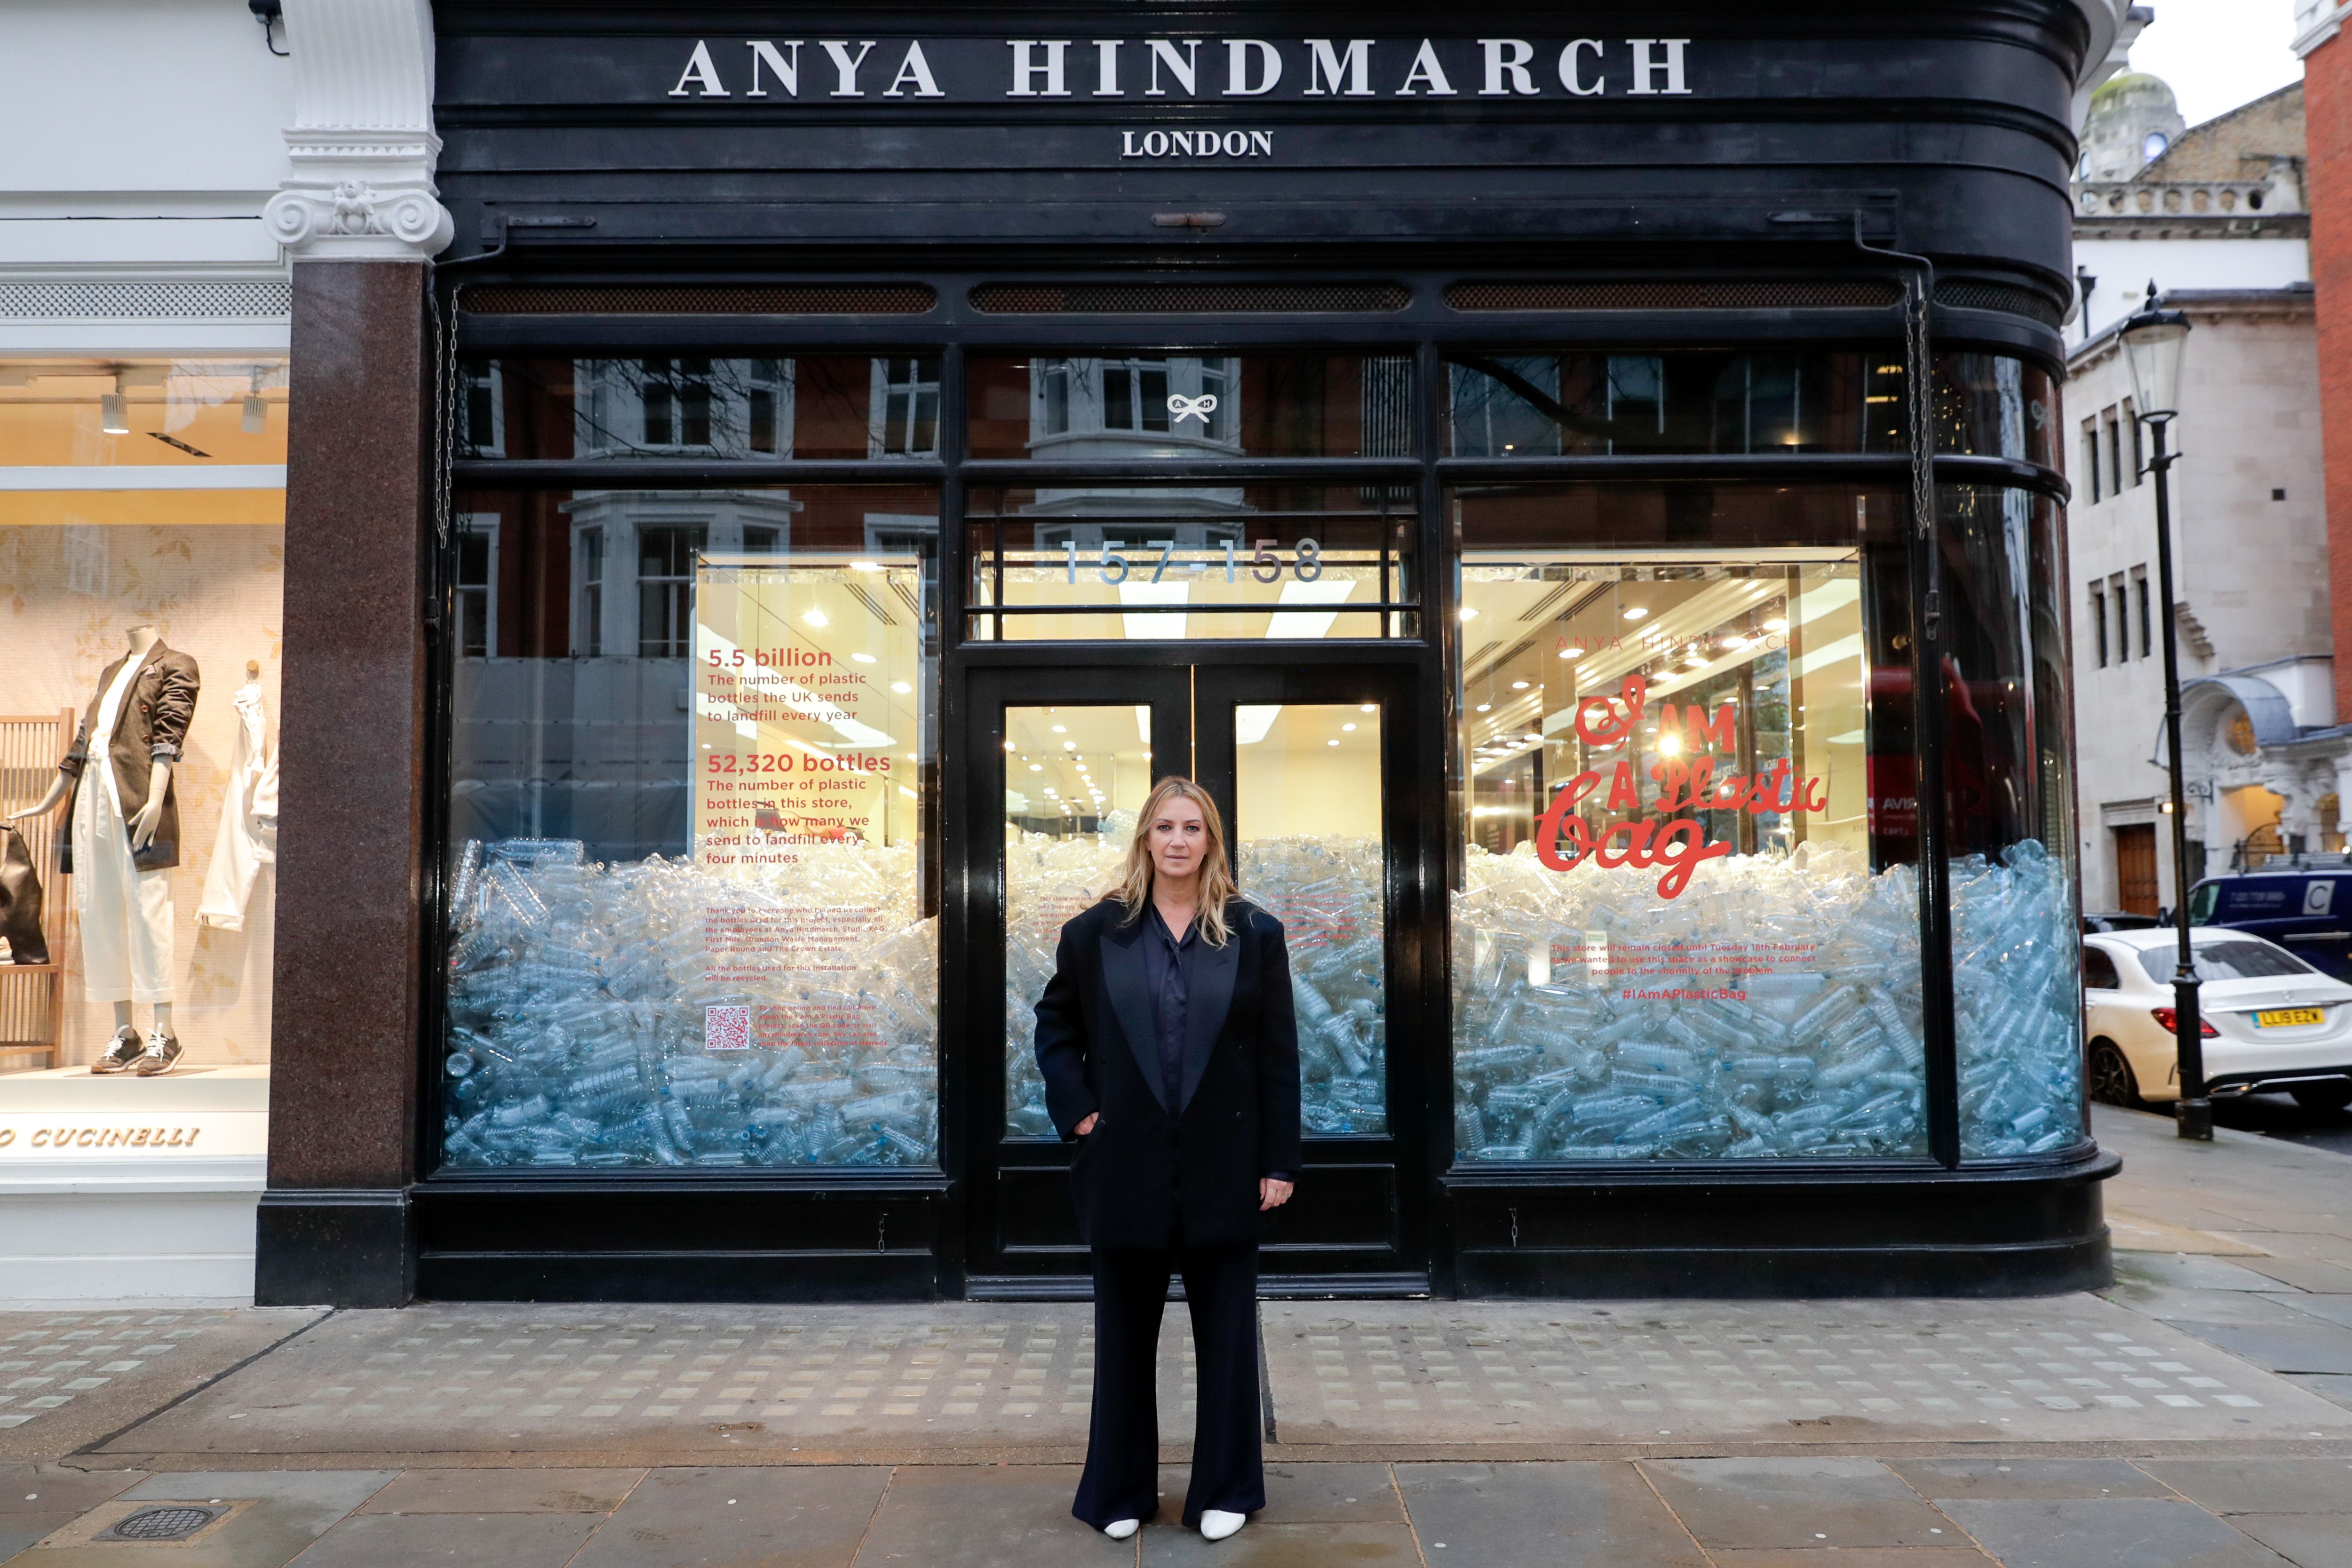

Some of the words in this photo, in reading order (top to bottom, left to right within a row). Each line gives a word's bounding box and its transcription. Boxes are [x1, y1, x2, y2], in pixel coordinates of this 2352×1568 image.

[668, 40, 945, 96] ANYA
[1006, 38, 1692, 96] HINDMARCH
[1122, 131, 1273, 157] LONDON
[1555, 636, 1623, 650] ANYA
[1642, 635, 1798, 650] HINDMRCH
[708, 649, 745, 668] 5.5
[755, 648, 832, 667] billion
[708, 674, 734, 685] The
[739, 674, 795, 685] number
[800, 674, 814, 685] of
[819, 673, 866, 686] plastic
[707, 692, 758, 703] bottles
[763, 692, 786, 703] the
[792, 692, 812, 702] UK
[818, 691, 858, 702] sends
[707, 711, 722, 722] to
[727, 710, 777, 721] landfill
[782, 712, 820, 723] every
[826, 711, 857, 722] year
[707, 754, 793, 776] 52,320
[803, 753, 890, 772] bottles
[707, 779, 733, 791] The
[739, 779, 795, 791] number
[800, 779, 814, 791] of
[819, 779, 866, 792] plastic
[1607, 761, 1639, 809] A
[707, 797, 758, 809] bottles
[763, 797, 776, 809] in
[781, 797, 807, 809] this
[811, 798, 852, 810] store,
[707, 816, 749, 828] which
[755, 816, 765, 828] is
[770, 816, 800, 828] how
[806, 817, 844, 828] many
[850, 817, 869, 827] we
[707, 834, 741, 845] send
[746, 835, 761, 845] to
[766, 834, 815, 845] landfill
[820, 836, 859, 847] every
[707, 852, 736, 864] four
[741, 852, 798, 864] minutes
[1710, 944, 1748, 953] Tuesday
[1773, 944, 1815, 953] February
[1592, 967, 1624, 976] people
[1733, 967, 1775, 975] problem.
[1622, 988, 1746, 1001] #IAmAPlasticBag
[31, 1128, 200, 1147] CUCINELLI
